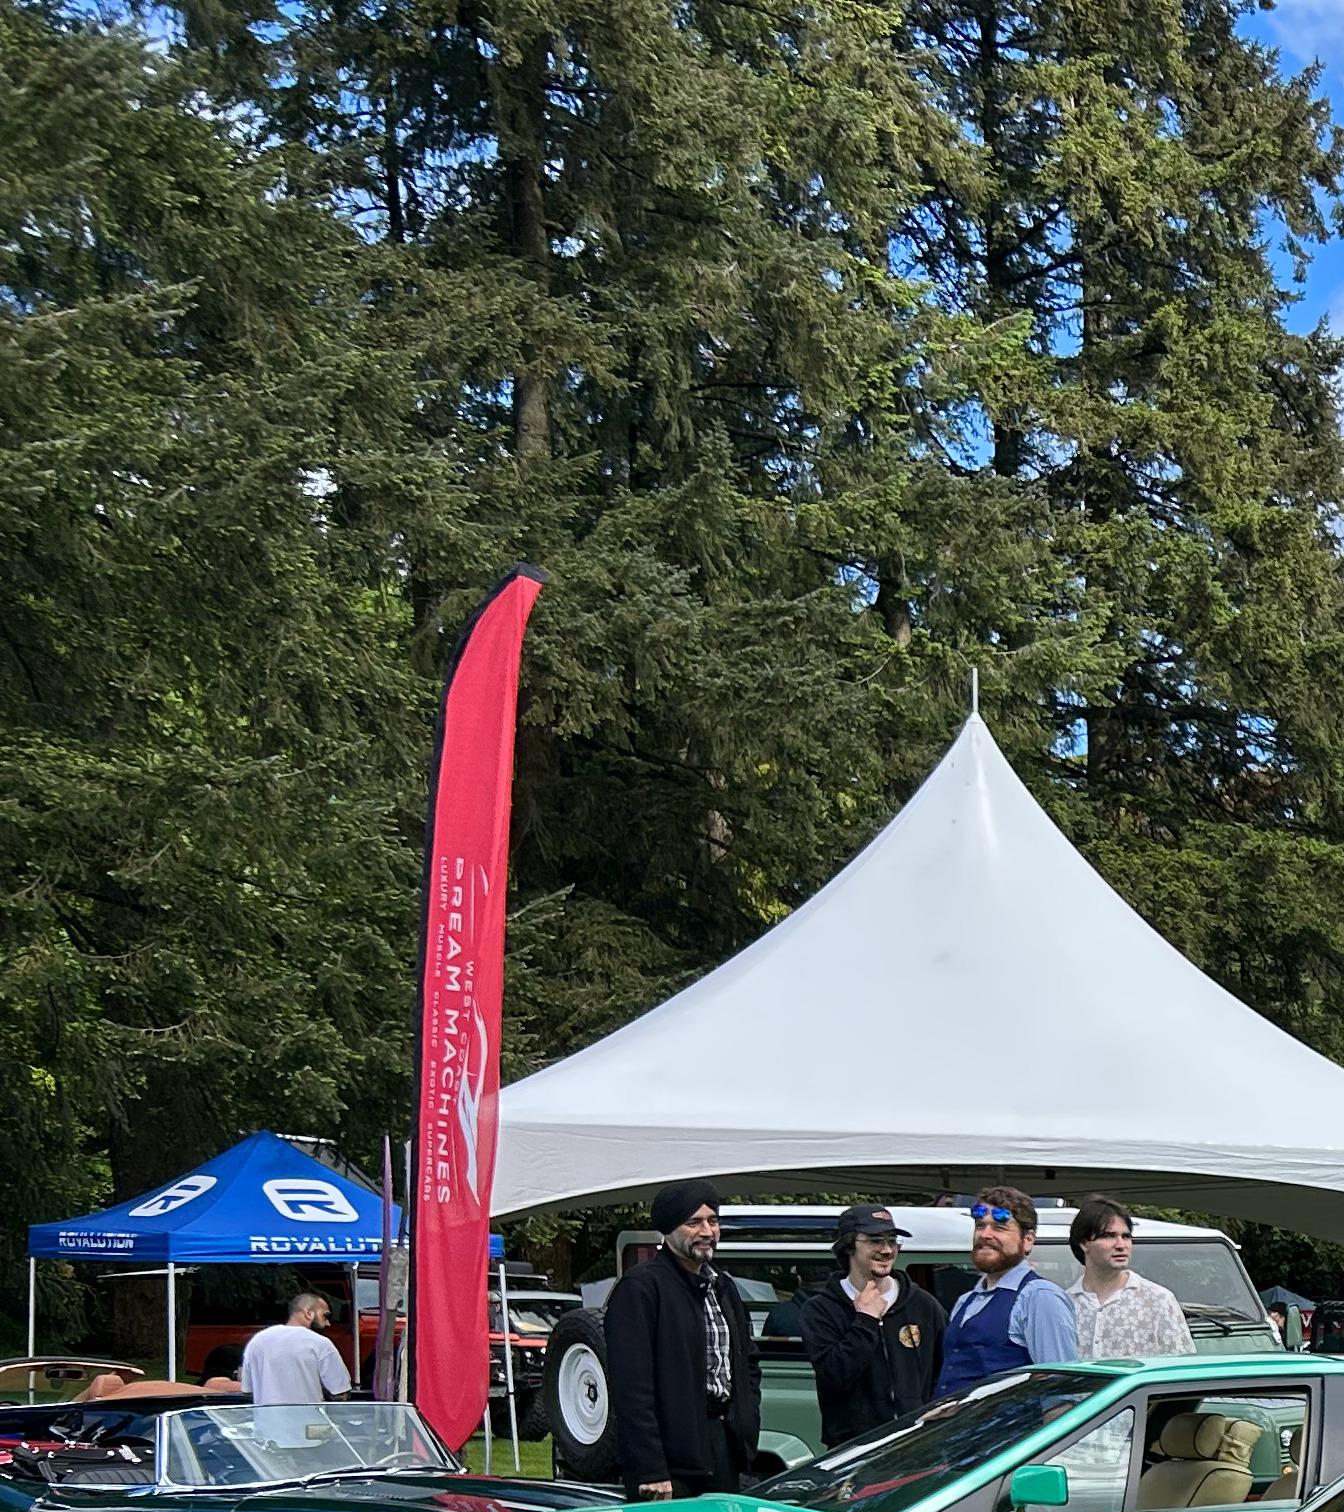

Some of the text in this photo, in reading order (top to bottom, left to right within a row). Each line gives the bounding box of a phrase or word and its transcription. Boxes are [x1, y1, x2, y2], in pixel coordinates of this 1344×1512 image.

[439, 856, 448, 911] LUXURY
[462, 960, 475, 1023] WEST
[437, 857, 465, 1204] DREAM MACHINES
[428, 1060, 438, 1110] EXOTIC
[249, 1236, 409, 1252] ROVALUT
